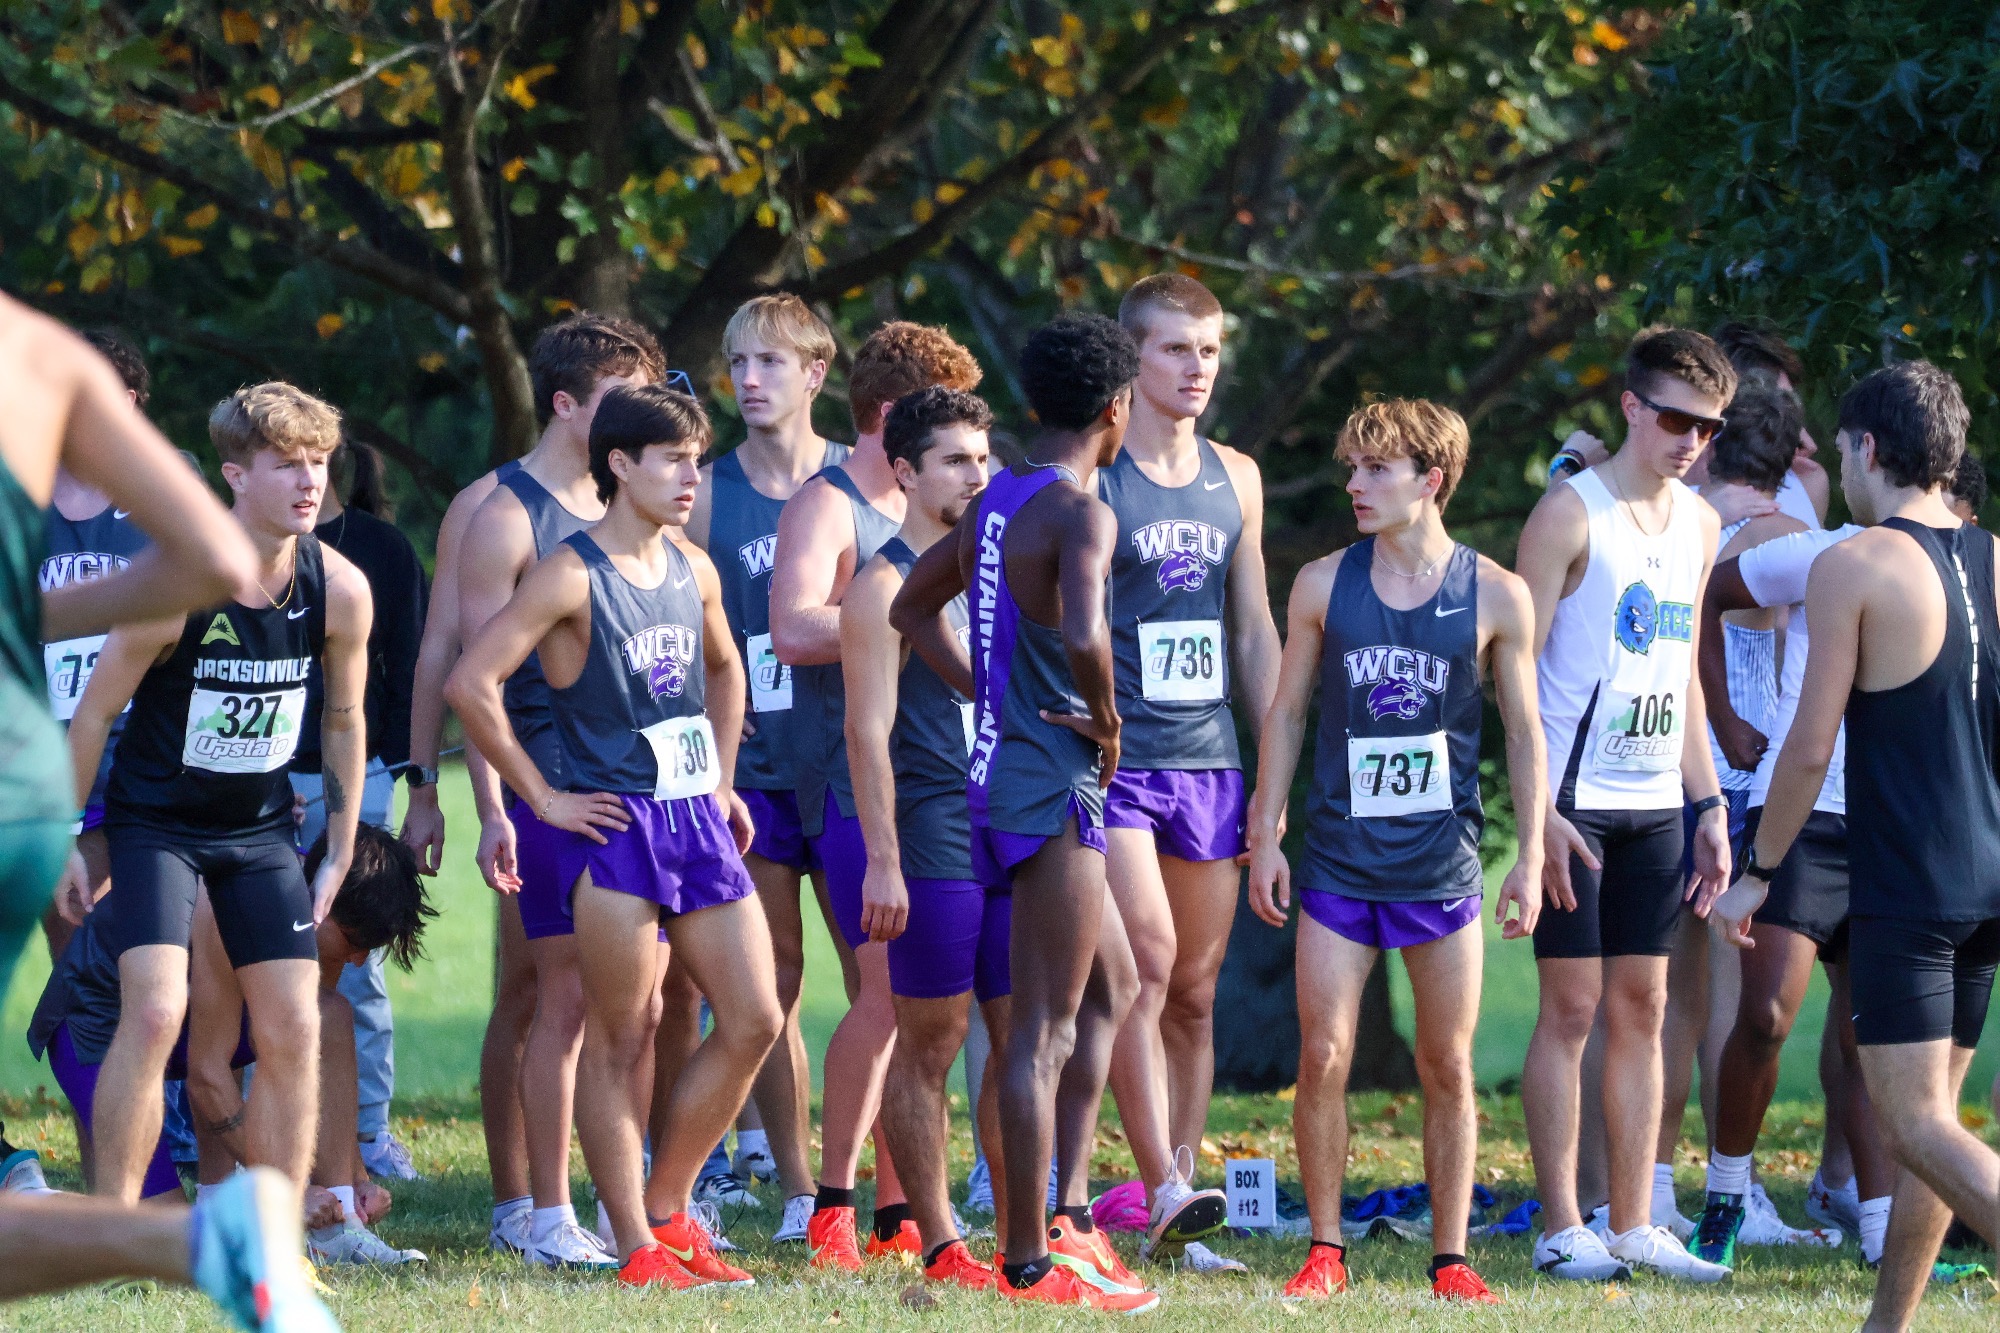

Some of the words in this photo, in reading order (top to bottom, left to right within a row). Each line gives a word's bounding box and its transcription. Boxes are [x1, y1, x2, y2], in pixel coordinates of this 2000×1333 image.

[1131, 519, 1227, 565] WCU
[622, 624, 695, 674] WCU
[1157, 636, 1213, 680] 736
[1344, 645, 1449, 695] WCU
[217, 695, 282, 739] 327
[1625, 692, 1674, 738] 106
[195, 735, 289, 759] Upstate
[662, 729, 708, 778] 730
[1366, 751, 1433, 796] 737
[1235, 1170, 1259, 1188] BOX
